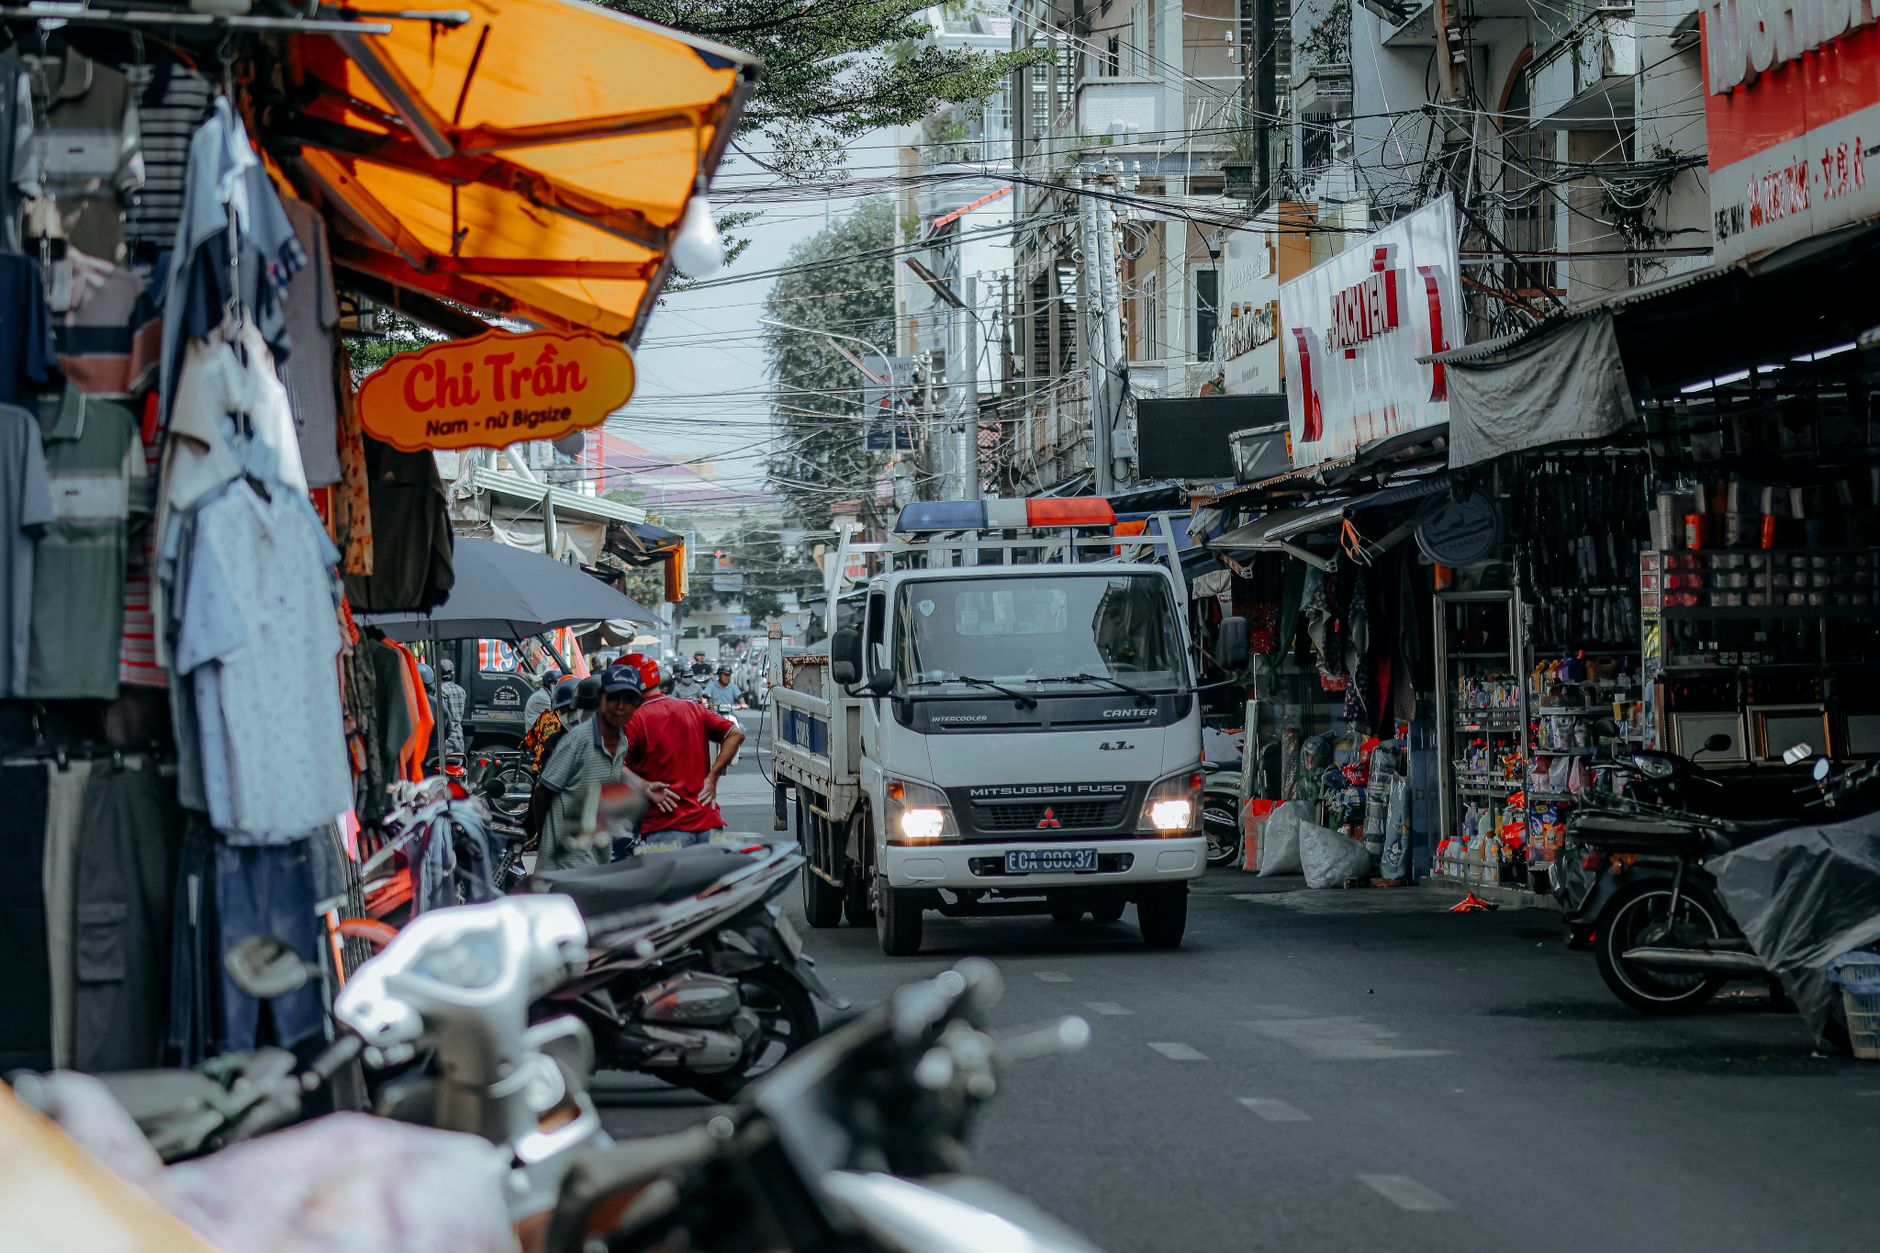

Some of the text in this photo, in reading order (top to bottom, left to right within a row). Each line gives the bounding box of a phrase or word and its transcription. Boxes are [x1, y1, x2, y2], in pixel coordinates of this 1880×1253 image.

[403, 342, 588, 412] Chi Trần
[425, 419, 468, 437] Nam
[485, 410, 510, 431] nữ
[512, 405, 571, 427] Bigsize
[1102, 708, 1158, 718] CANTER
[970, 784, 1126, 797] MITSUBISHI FUSO
